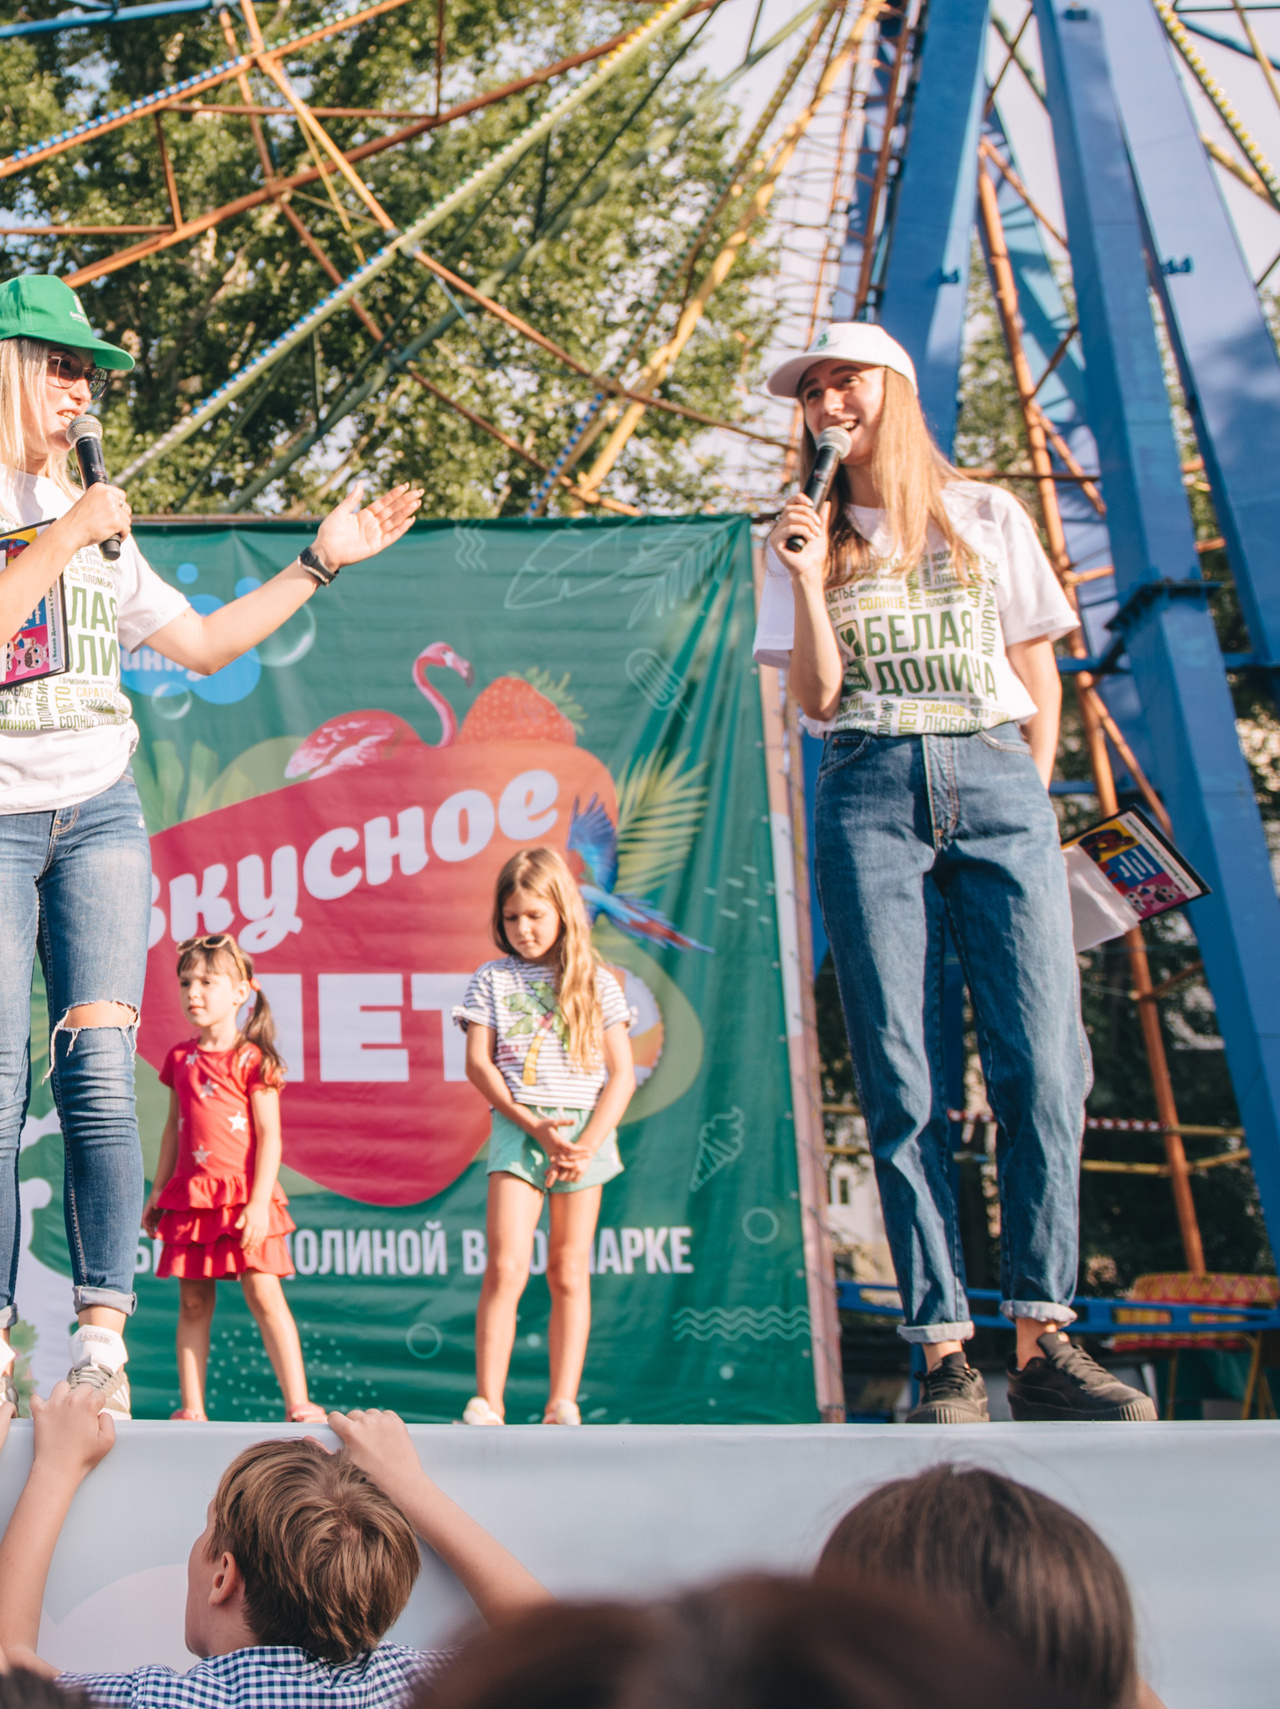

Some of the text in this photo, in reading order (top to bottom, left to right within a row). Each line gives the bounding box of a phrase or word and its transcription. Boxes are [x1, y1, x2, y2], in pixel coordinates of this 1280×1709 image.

[858, 596, 905, 611] СОЛНЦЕ
[863, 610, 974, 657] БЕЛАЯ
[874, 653, 997, 701] ДОЛИНА
[877, 699, 895, 736] ОМБИР
[898, 702, 919, 735] ЛЕТО
[923, 702, 966, 717] САРАТОВ
[284, 1220, 448, 1280] ОЛИНОЙ
